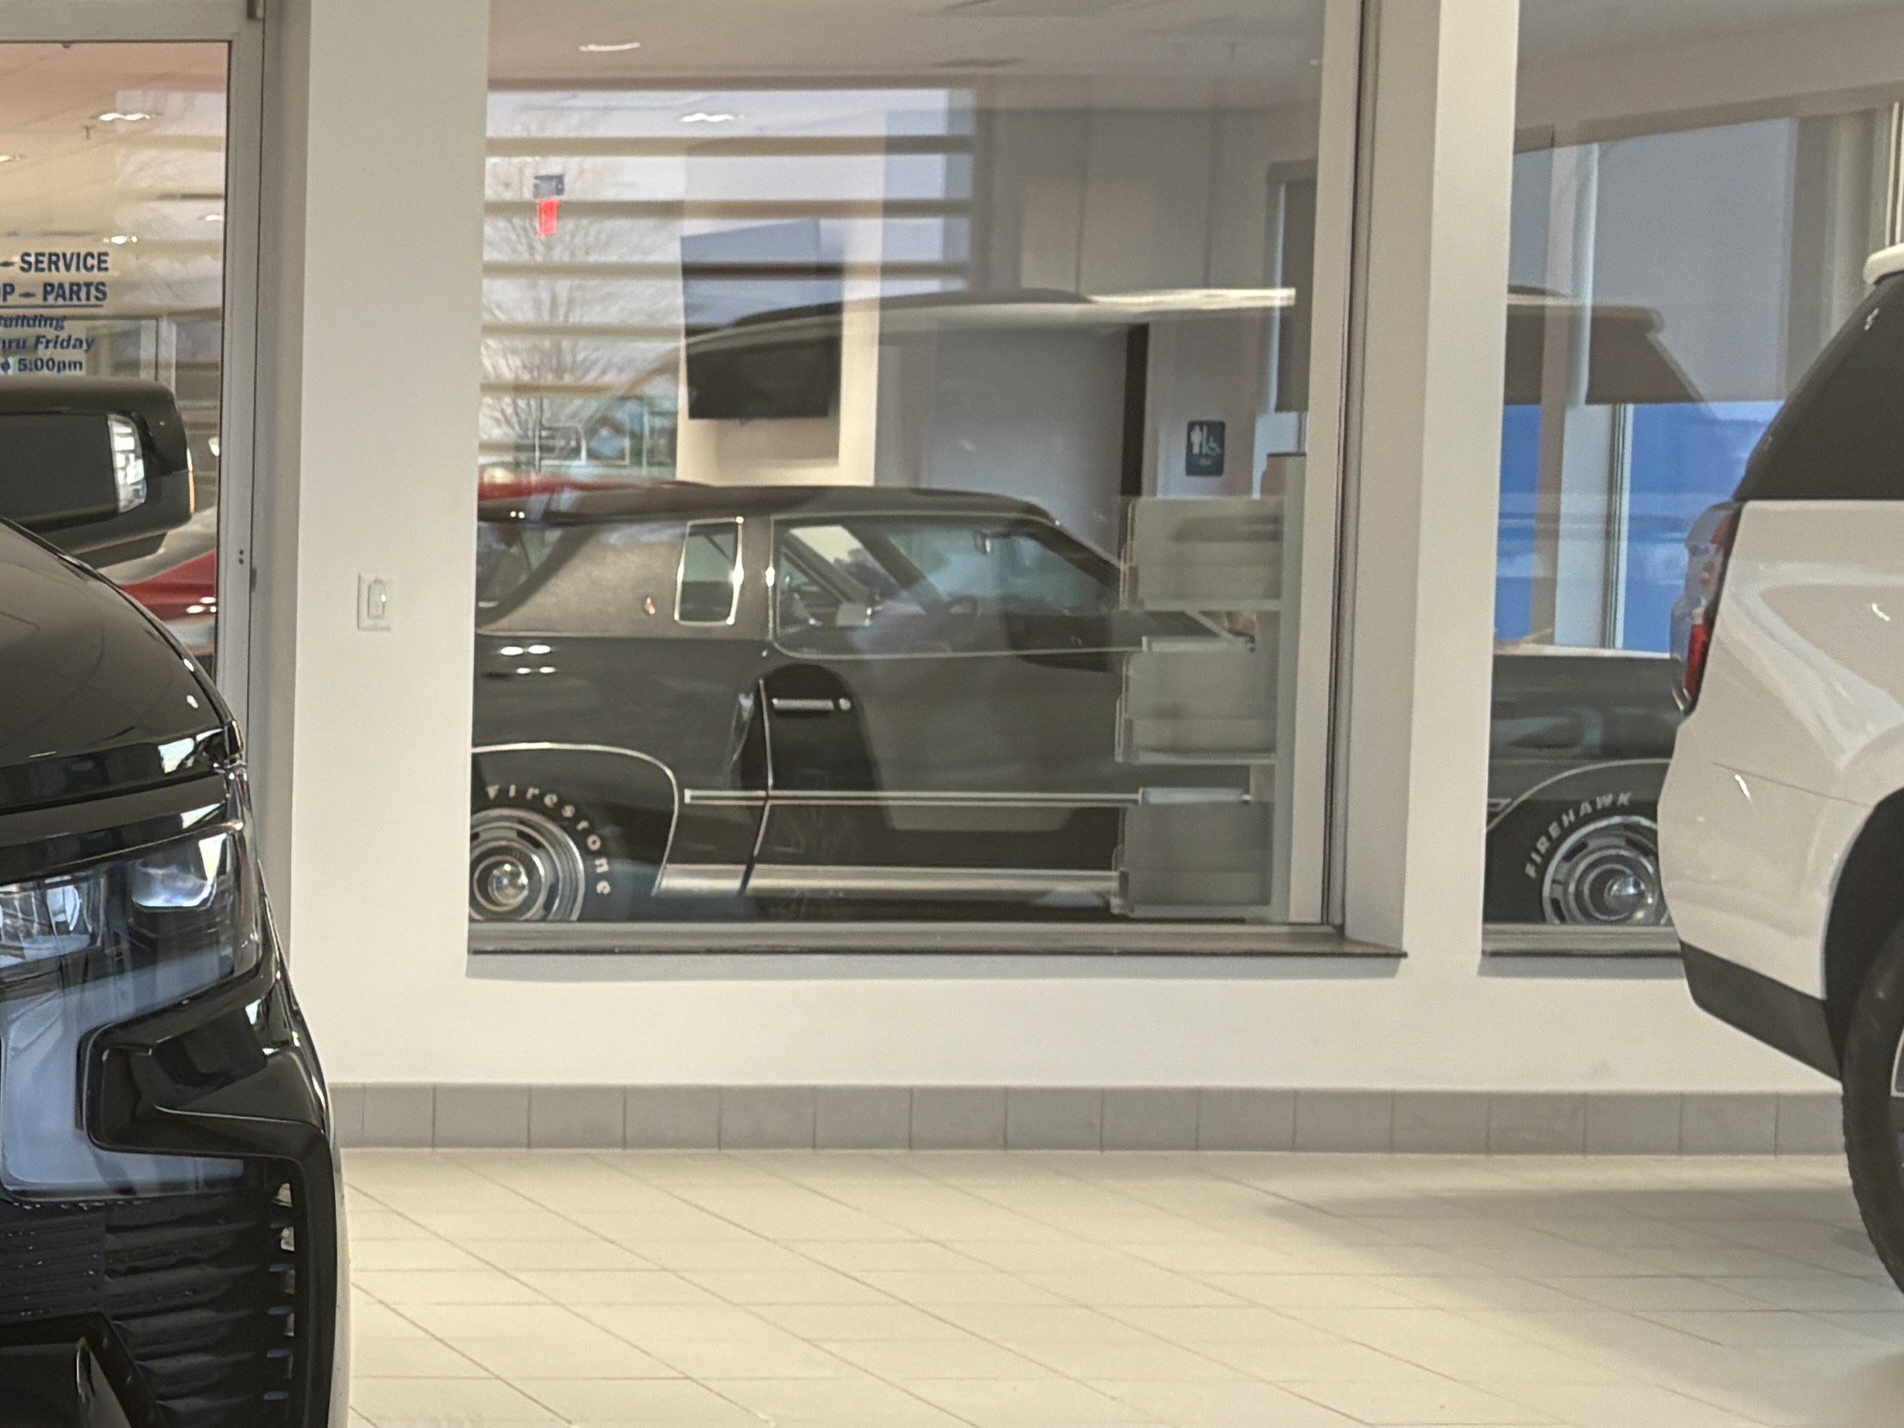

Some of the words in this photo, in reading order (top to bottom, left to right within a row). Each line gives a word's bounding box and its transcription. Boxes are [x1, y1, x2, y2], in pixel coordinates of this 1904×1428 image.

[19, 251, 110, 273] SERVICE
[43, 281, 108, 303] PARTS
[34, 334, 96, 353] Friday
[17, 357, 83, 373] 5:00pm
[1524, 791, 1633, 879] FIREHAWK
